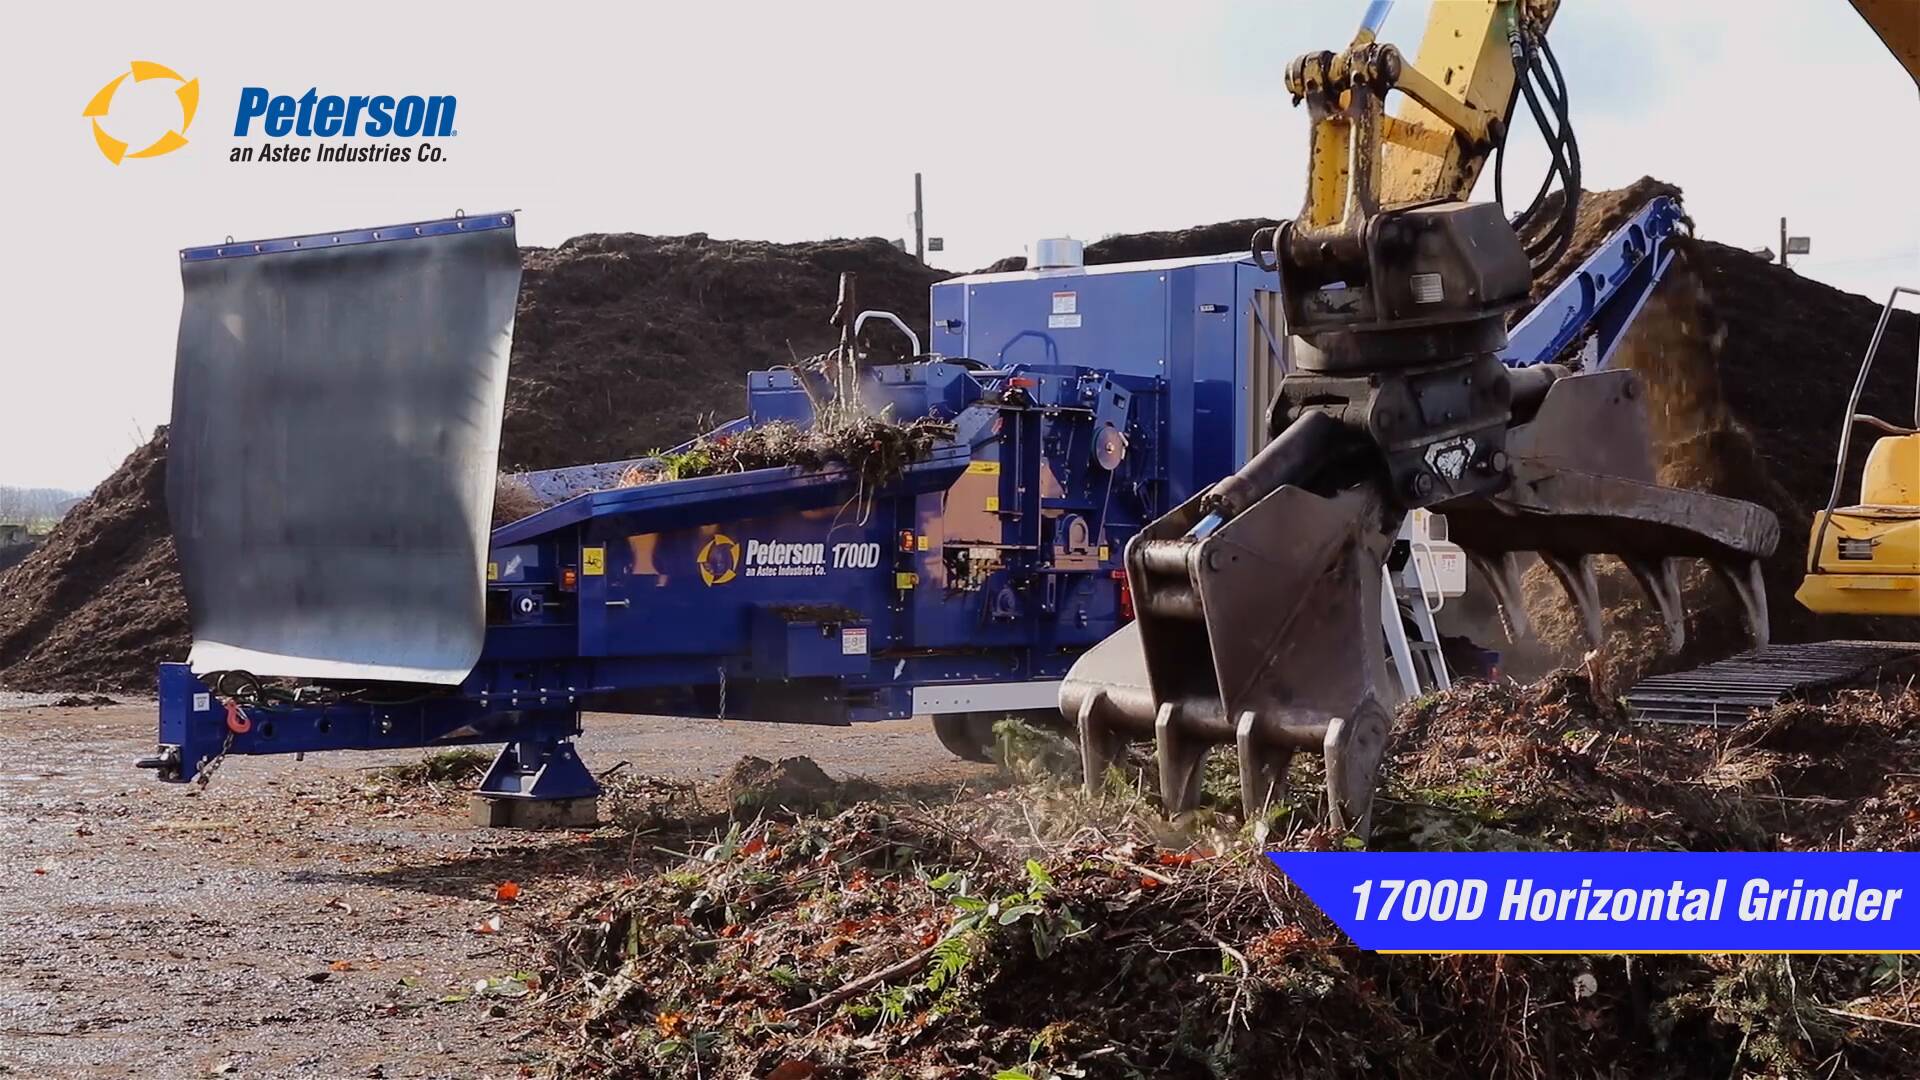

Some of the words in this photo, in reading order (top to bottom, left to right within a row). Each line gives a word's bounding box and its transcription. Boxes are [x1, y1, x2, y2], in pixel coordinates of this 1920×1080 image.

[832, 543, 880, 568] 1700D
[745, 567, 756, 577] an
[756, 566, 777, 576] Astec
[778, 565, 813, 576] Industries
[814, 564, 826, 576] Co.
